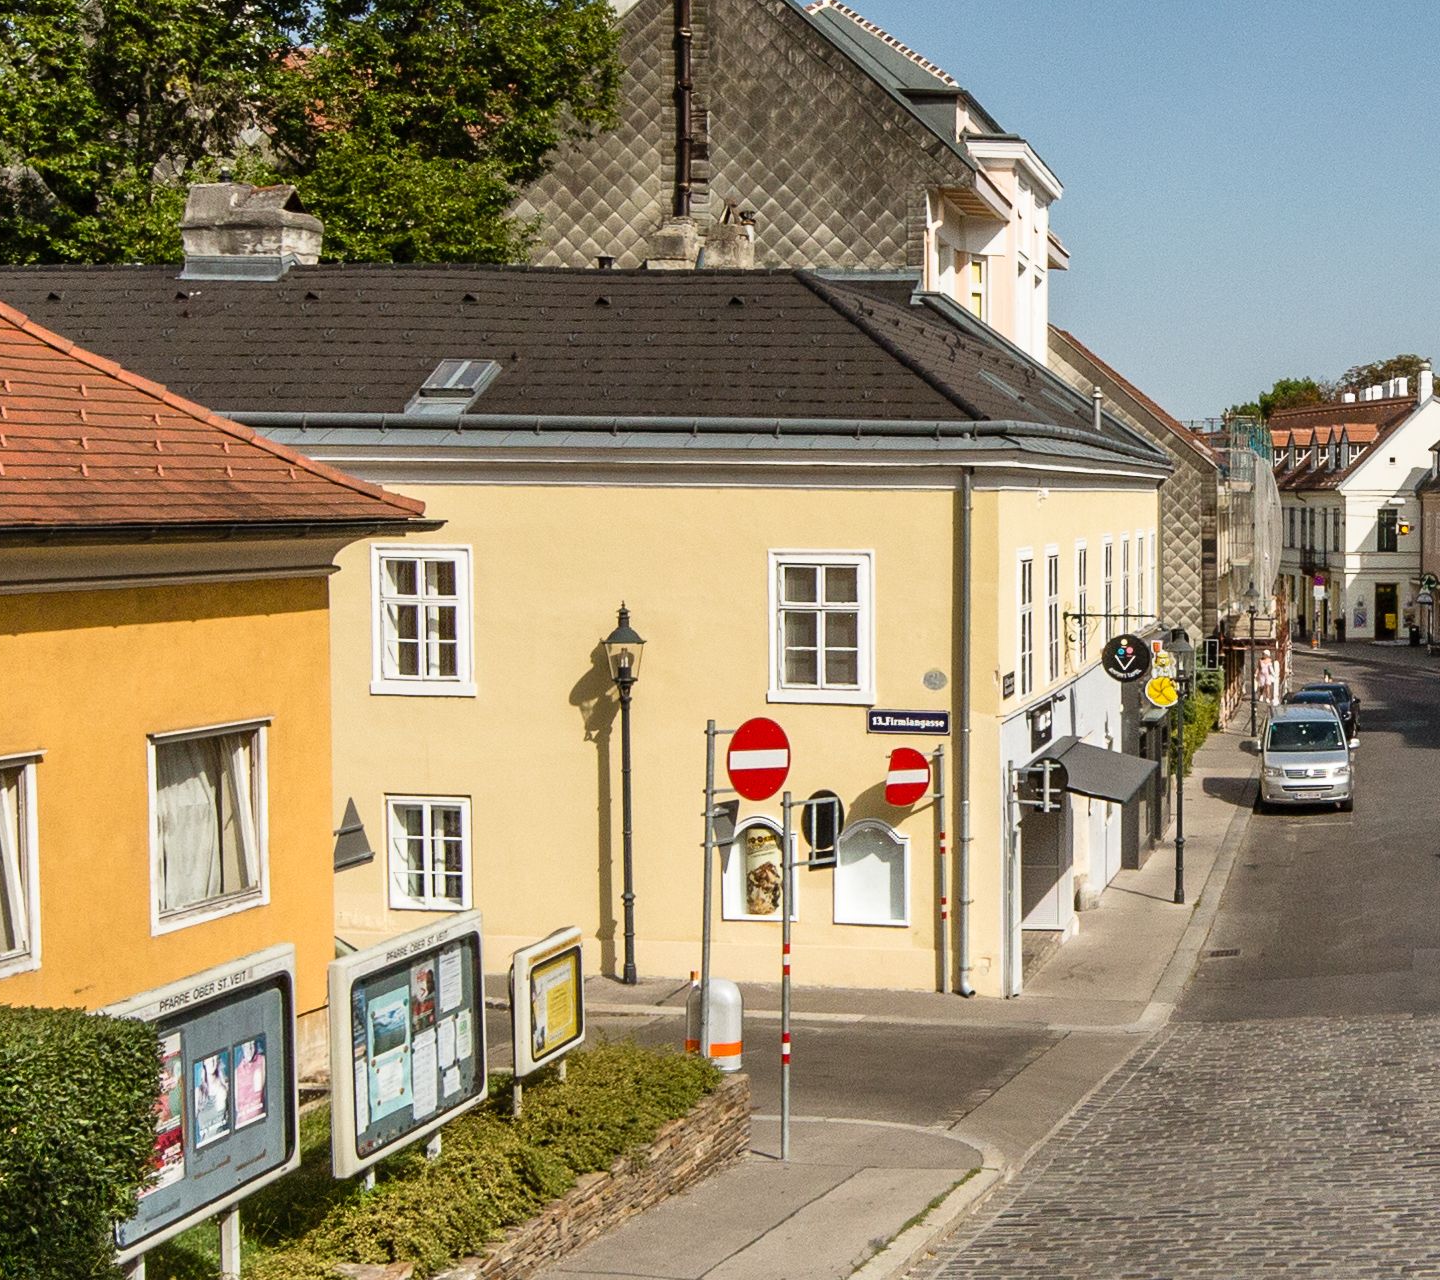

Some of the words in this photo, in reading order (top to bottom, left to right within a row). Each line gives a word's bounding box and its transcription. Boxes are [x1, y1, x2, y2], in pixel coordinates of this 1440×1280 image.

[386, 943, 408, 962] PFARRE
[410, 938, 426, 953] OBER
[159, 991, 190, 1012] PFARRE
[193, 983, 215, 1000] OBER
